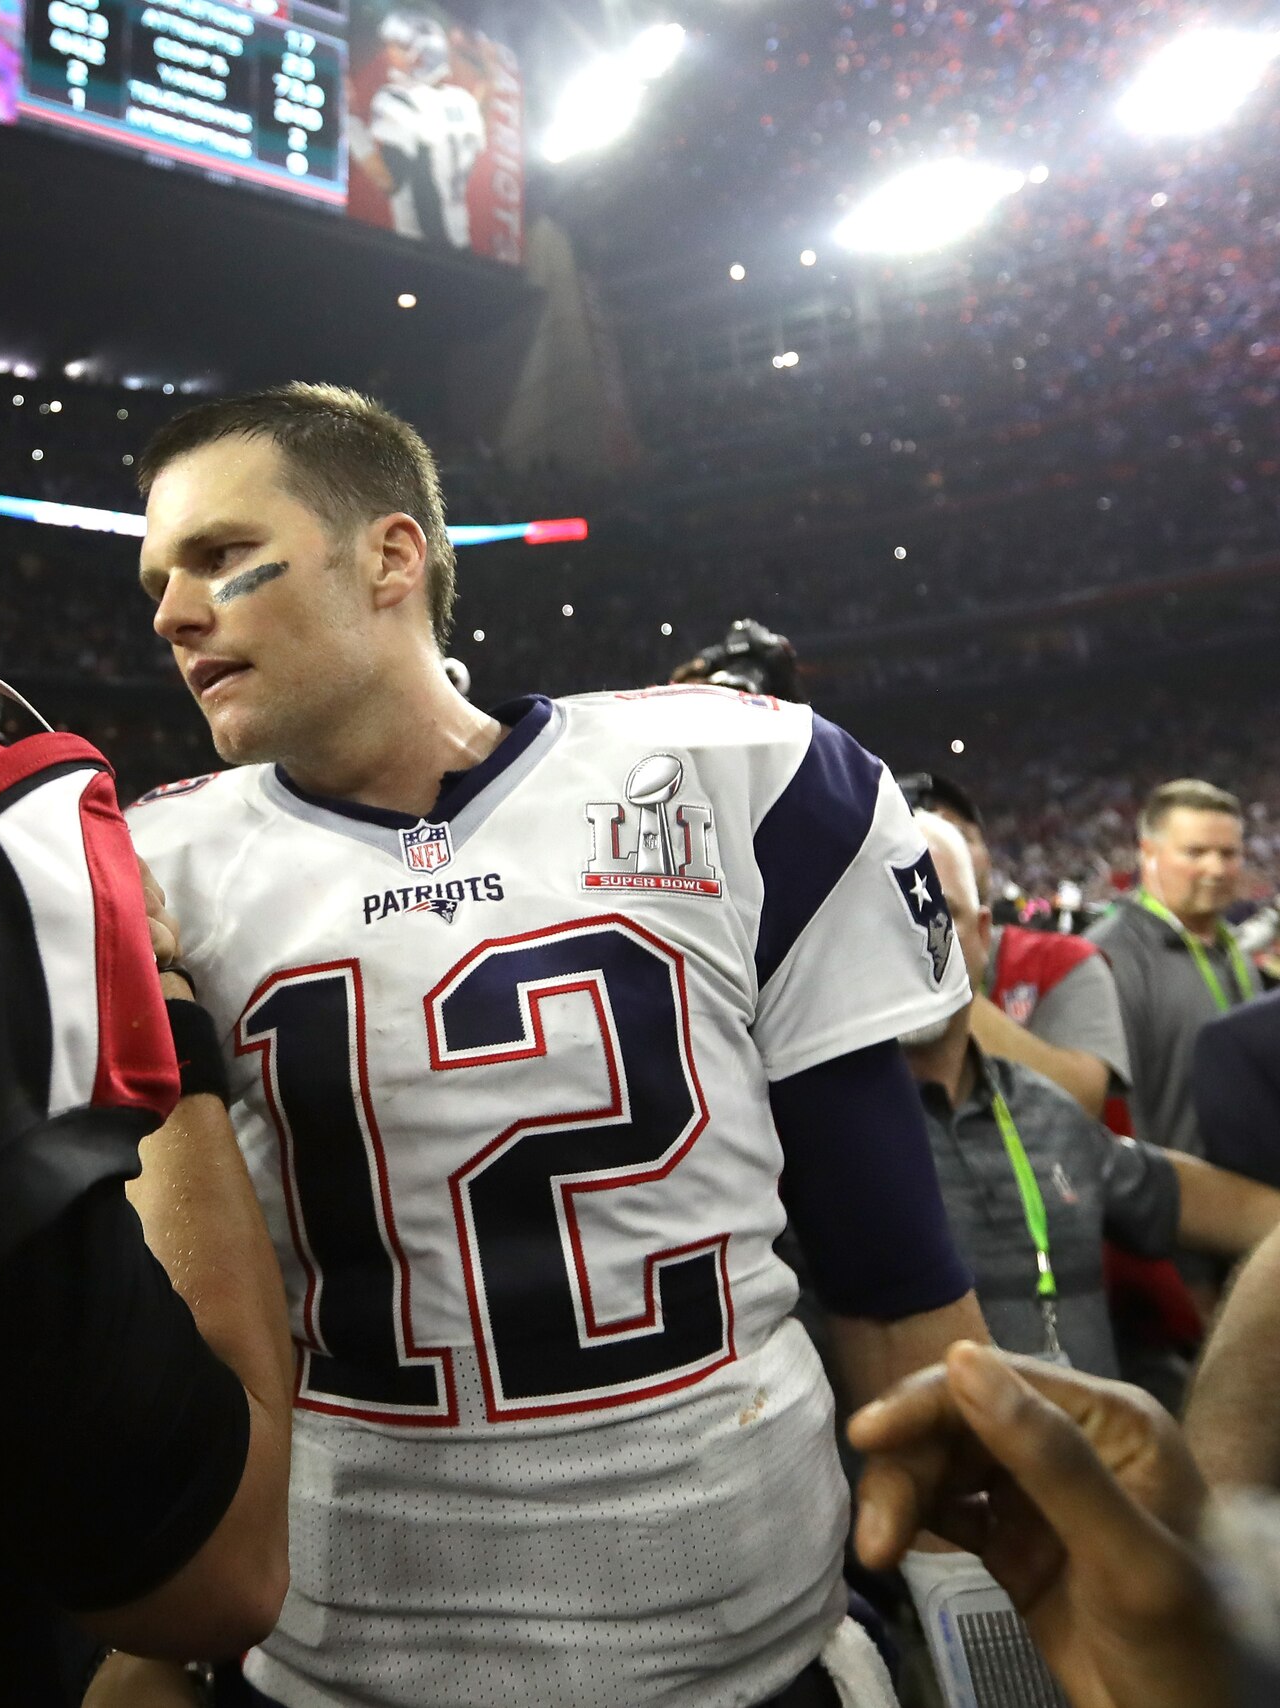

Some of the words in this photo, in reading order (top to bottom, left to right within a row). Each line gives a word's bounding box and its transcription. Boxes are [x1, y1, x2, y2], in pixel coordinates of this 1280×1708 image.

[409, 842, 447, 869] NFL
[362, 872, 505, 925] PATRIOTS
[600, 875, 656, 887] SUPER
[661, 878, 705, 892] BOWL
[233, 912, 739, 1429] 12
